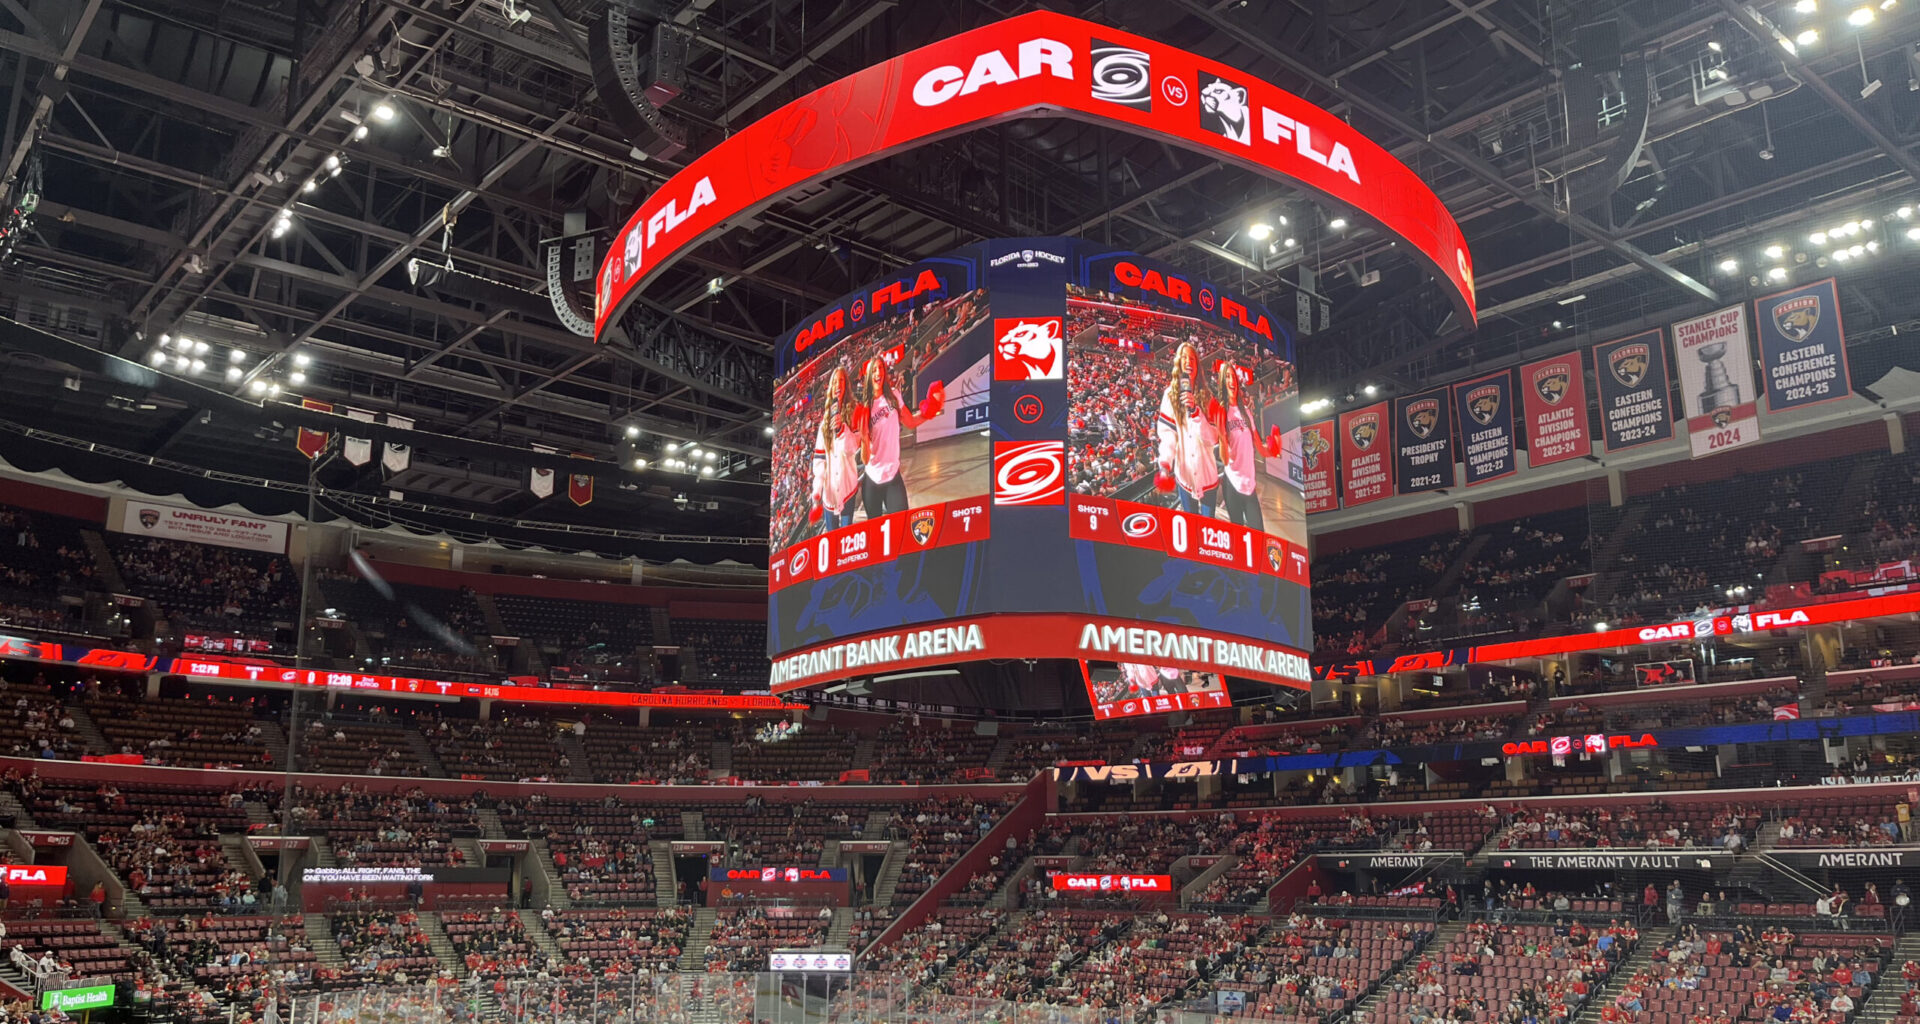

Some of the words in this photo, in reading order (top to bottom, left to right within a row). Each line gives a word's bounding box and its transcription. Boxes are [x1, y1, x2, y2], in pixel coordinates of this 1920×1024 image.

[912, 37, 1074, 107] CAR
[1167, 84, 1183, 98] VS
[1262, 106, 1361, 185] FLA
[647, 176, 717, 250] FLA
[990, 252, 1020, 267] FLORIDA
[1035, 250, 1065, 264] HOCKEY
[1114, 262, 1192, 305] CAR
[1202, 296, 1211, 306] VS
[1221, 296, 1274, 341] FLA
[795, 309, 844, 352] CAR
[853, 306, 862, 316] VS
[872, 269, 941, 313] FLA
[1678, 317, 1717, 338] STANLEY
[1720, 311, 1739, 326] CUP
[1682, 323, 1738, 349] CHAMPIONS
[1779, 343, 1825, 364] EASTERN
[1772, 354, 1837, 378] CONFERENCE
[1775, 367, 1837, 390] CHAMPIONS
[1615, 388, 1653, 407] EASTERN
[1786, 382, 1829, 401] 2024-25
[1020, 404, 1038, 415] VS
[1538, 407, 1574, 424] ATLANTIC
[1609, 399, 1662, 420] CONFERENCE
[1540, 418, 1574, 436] DIVISION
[1612, 411, 1662, 432] CHAMPIONS
[1471, 426, 1502, 443] EASTERN
[1535, 428, 1581, 448] CHAMPIONS
[1620, 425, 1656, 442] 2023-24
[1708, 428, 1741, 449] 2024
[1401, 439, 1447, 457] PRESIDENTS'
[1467, 435, 1509, 455] CONFERENCE
[1543, 441, 1575, 458] 2023-24
[1352, 453, 1380, 468] ATLANTIC
[1411, 452, 1439, 466] TROPHY
[1469, 447, 1508, 466] CHAMPIONS
[1352, 463, 1381, 478] DIVISION
[1476, 459, 1503, 475] 2022-23
[1304, 470, 1328, 482] LANTIC
[1348, 473, 1386, 490] CHAMPIONS
[1410, 473, 1441, 488] 2021-22
[1304, 480, 1327, 490] VISION
[1355, 484, 1381, 499] 2021-22
[952, 506, 982, 518] SHOTS
[1077, 504, 1109, 516] SHOTS
[1305, 499, 1327, 510] 015-16
[172, 511, 229, 525] UNRULY
[231, 520, 267, 530] FAN?
[963, 516, 971, 532] 7
[1089, 515, 1097, 531] 9
[818, 537, 829, 573] 0
[840, 531, 866, 555] 12:09
[880, 519, 890, 556] 1
[1172, 514, 1188, 553] 0
[1201, 526, 1230, 550] 12:09
[1243, 532, 1253, 568] 1
[836, 557, 848, 567] 2nd
[848, 552, 869, 564] PERIOD
[1199, 547, 1212, 557] 2nd
[1211, 550, 1234, 561] PERIOD
[1638, 624, 1689, 640] CAR
[1756, 610, 1810, 628] FLA
[769, 644, 847, 686] AMERANT
[846, 635, 901, 668] BANK
[902, 624, 985, 659] ARENA
[1079, 623, 1213, 663] AMERANT
[1214, 639, 1266, 672] BANK
[1266, 649, 1312, 682] ARENA
[191, 662, 207, 674] 7:12
[207, 664, 220, 675] PM
[307, 671, 316, 684] 0
[355, 680, 379, 688] PERIOD
[391, 678, 397, 691] 1
[632, 694, 673, 705] CAROLINA
[676, 696, 728, 706] HURRICANES
[742, 697, 777, 707] FLORIDA
[1502, 740, 1548, 755] CAR
[1608, 733, 1658, 748] FLA
[1084, 764, 1139, 781] VS
[58, 836, 71, 845] 125
[285, 840, 299, 849] 127
[1370, 856, 1425, 868] AMERANT
[1529, 856, 1553, 868] THE
[1557, 856, 1625, 868] AMERANT
[1629, 856, 1680, 868] VAULT
[1818, 852, 1904, 867] AMERANT
[9, 869, 47, 881] FLA
[727, 870, 760, 880] CAR
[800, 870, 831, 880] FLA
[1067, 877, 1097, 888] CAR
[1131, 878, 1158, 888] FLA
[62, 994, 86, 1008] Baptist
[86, 991, 108, 1003] Health
